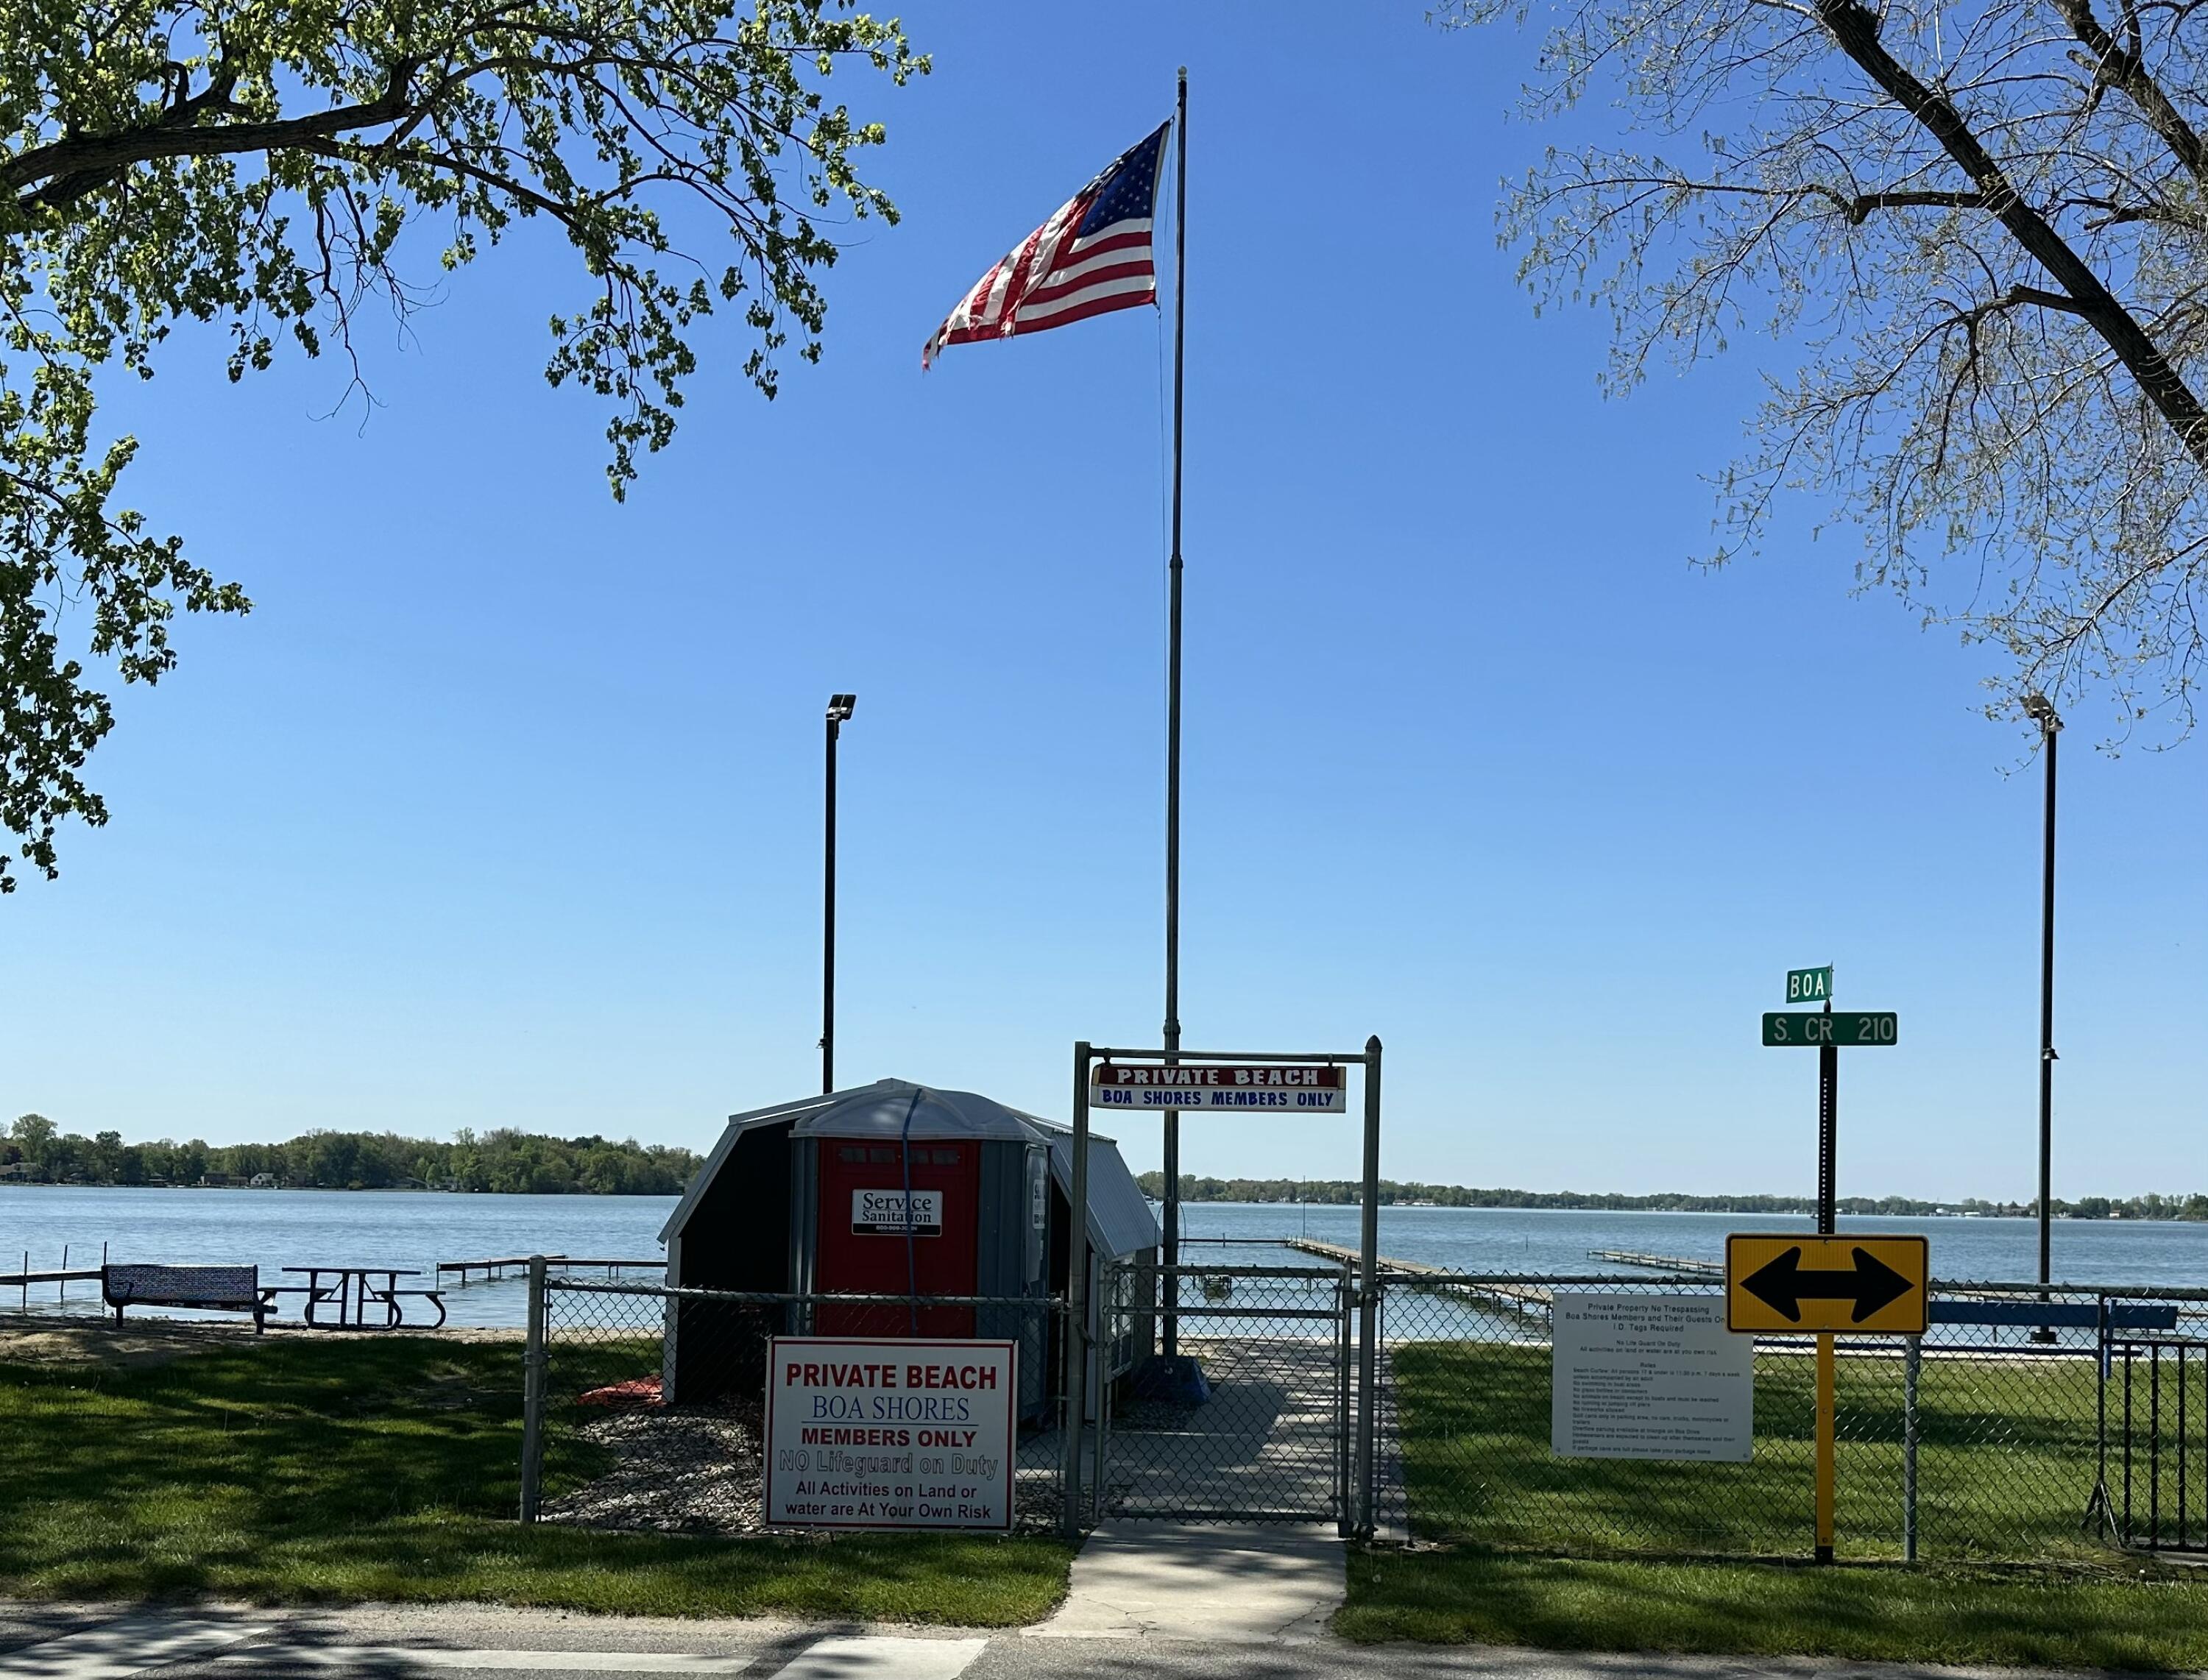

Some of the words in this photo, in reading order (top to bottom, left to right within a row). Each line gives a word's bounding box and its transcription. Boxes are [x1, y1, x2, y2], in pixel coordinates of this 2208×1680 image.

[1791, 973, 1825, 999] BOA
[1774, 1017, 1791, 1041] S.
[1805, 1017, 1833, 1041] CR
[1858, 1017, 1894, 1041] 210
[1117, 1069, 1219, 1085] PRIVATE
[1234, 1069, 1318, 1085] BEACH
[1103, 1089, 1132, 1105] BOA
[1143, 1091, 1202, 1105] SHORES
[1211, 1091, 1288, 1106] MEMBERS
[1297, 1092, 1334, 1107] ONLY
[863, 1192, 932, 1211] Servce
[862, 1210, 932, 1223] Sanitaion
[1582, 1312, 1609, 1320] Shores
[1685, 1315, 1712, 1323] Guests
[1617, 1303, 1649, 1313] Property
[1664, 1305, 1709, 1314] Trespassing
[1628, 1323, 1647, 1332] Tags
[1649, 1324, 1684, 1332] Required
[786, 1364, 896, 1387] PRIVATE
[907, 1365, 997, 1389] BEACH
[813, 1395, 864, 1419] BOA
[873, 1397, 969, 1421] SHORES
[802, 1428, 910, 1447] MEMBERS
[918, 1431, 977, 1447] ONLY
[779, 1450, 810, 1471] NO
[817, 1450, 913, 1478] Lifeguard
[920, 1459, 944, 1475] on
[952, 1453, 998, 1481] Duty
[796, 1481, 815, 1495] All
[820, 1481, 890, 1496] Activities
[895, 1486, 913, 1497] on
[919, 1484, 955, 1498] Land
[961, 1486, 977, 1498] or
[785, 1503, 827, 1514] water
[831, 1505, 853, 1516] are
[858, 1503, 874, 1517] At
[880, 1503, 914, 1518] Your
[920, 1504, 952, 1518] Own
[958, 1505, 991, 1520] Risk
